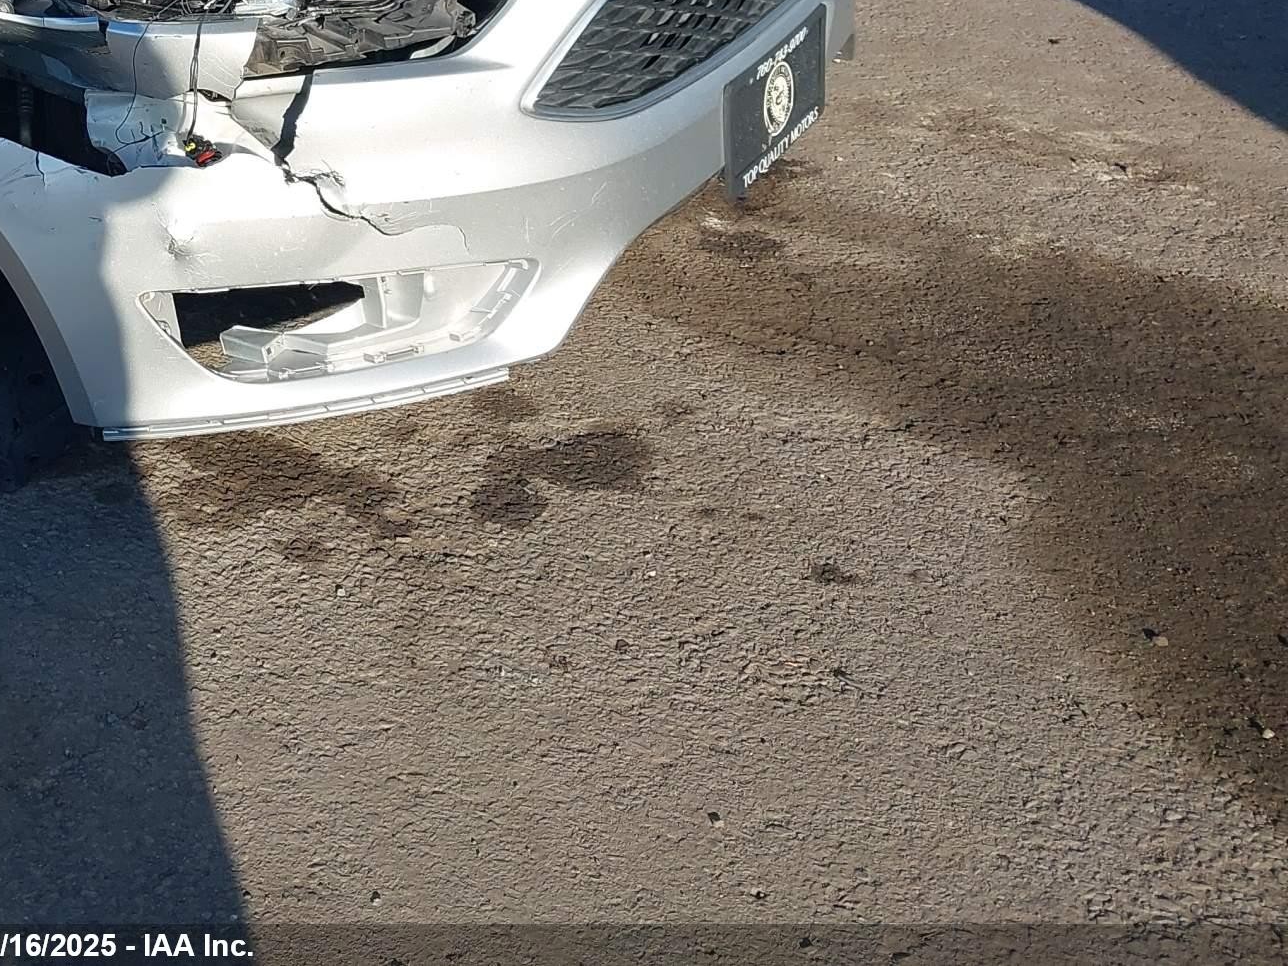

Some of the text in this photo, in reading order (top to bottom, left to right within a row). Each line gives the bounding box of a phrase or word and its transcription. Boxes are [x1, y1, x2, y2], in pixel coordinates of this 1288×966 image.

[742, 106, 820, 188] TOP QUALITY MOTORS
